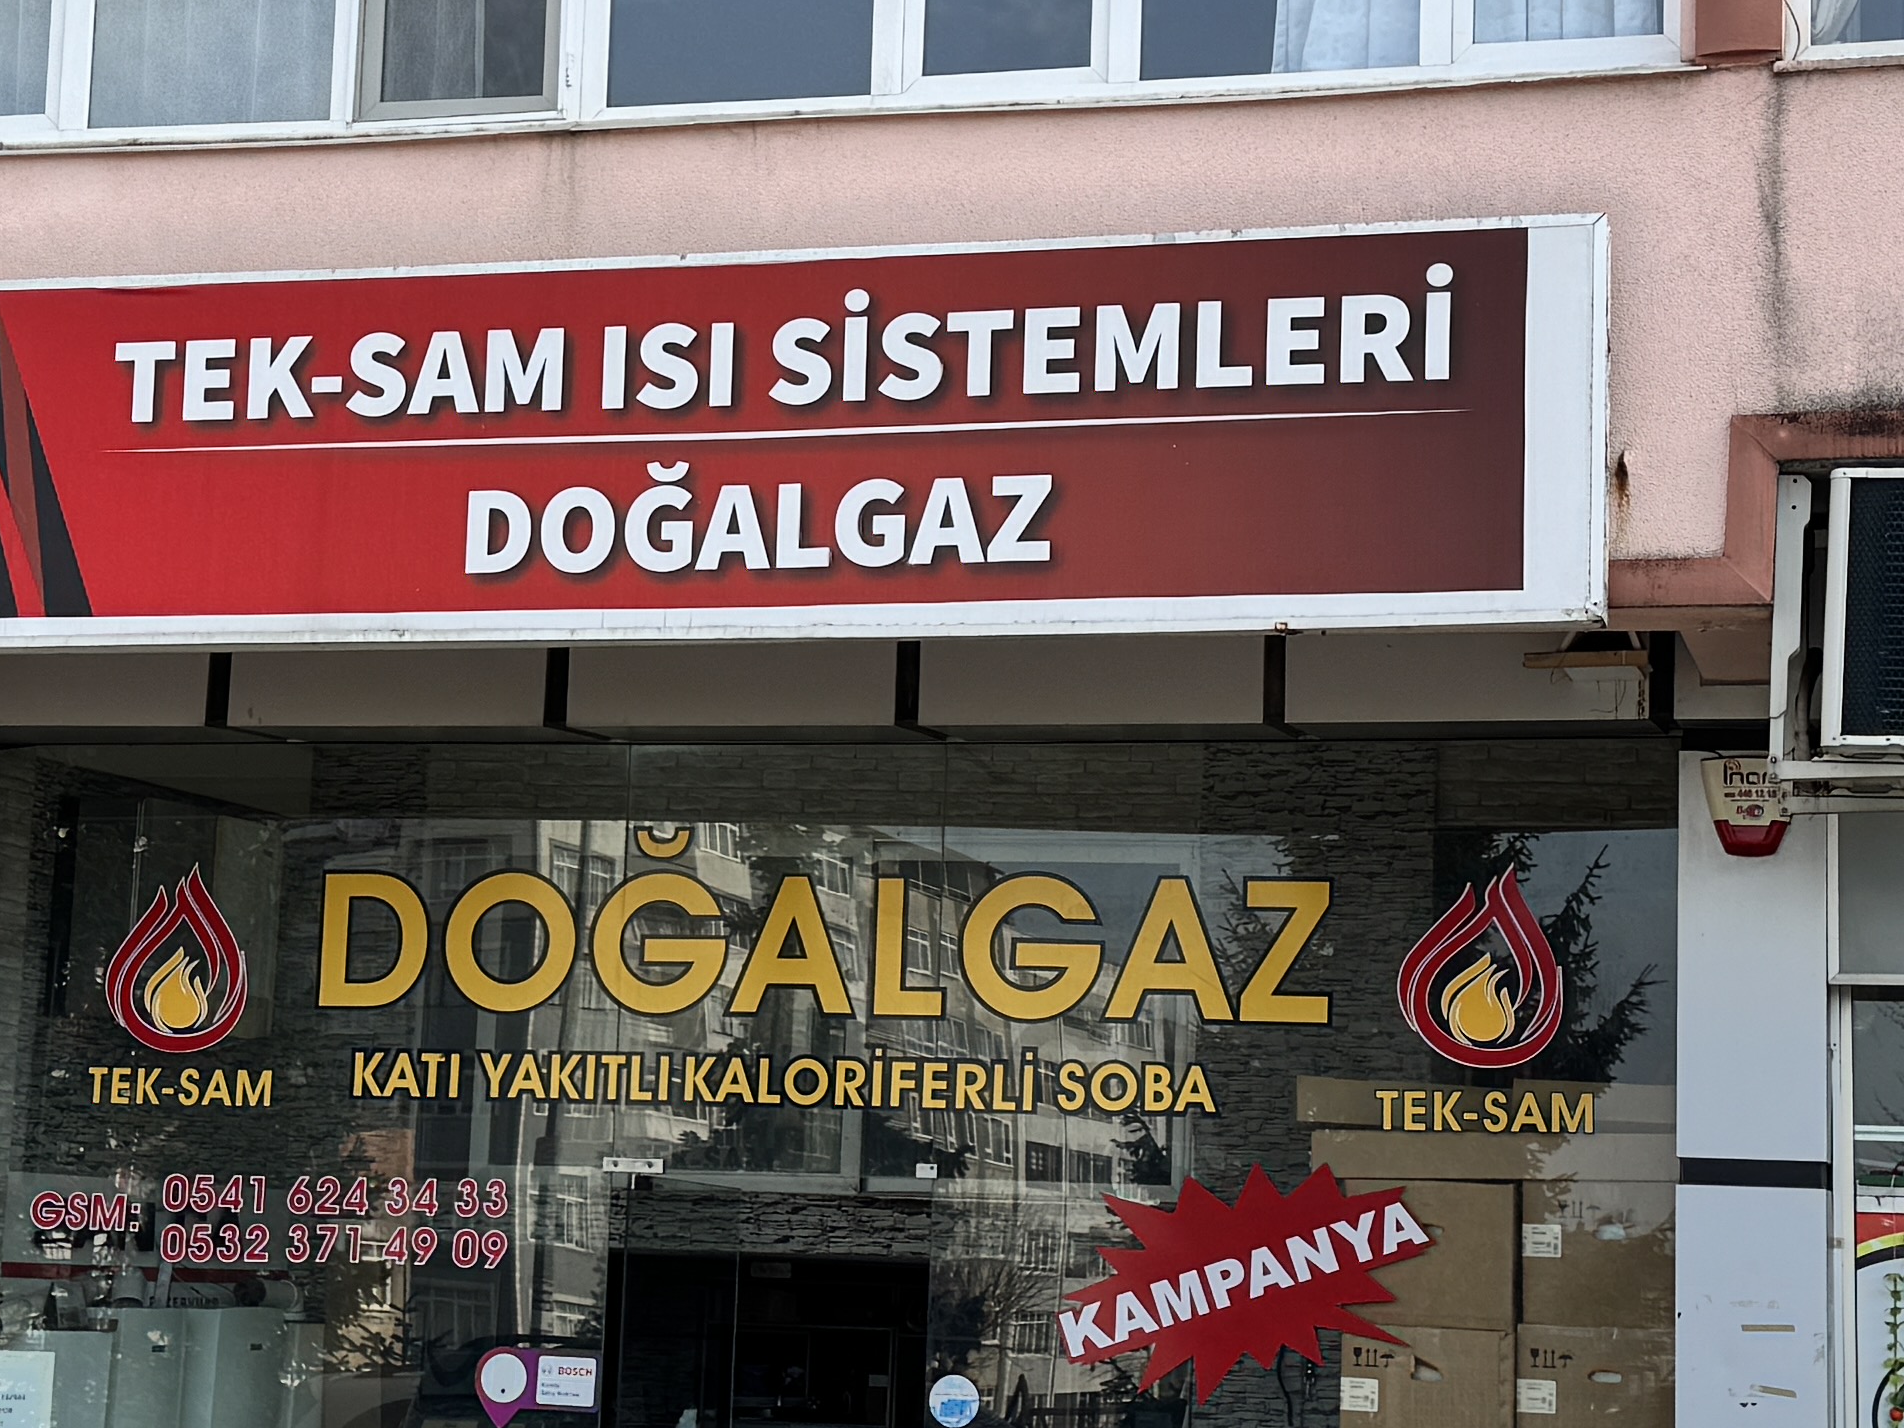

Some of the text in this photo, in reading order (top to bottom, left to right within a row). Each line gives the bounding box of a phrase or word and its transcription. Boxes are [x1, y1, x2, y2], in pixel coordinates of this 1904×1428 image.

[114, 261, 1452, 424] TEK-SAM ISI SİSTEMLERİ
[464, 460, 1053, 576] DOĞALGAZ
[316, 825, 1332, 1025] DOĞALGAZ
[89, 1066, 274, 1107] TEK-SAM
[352, 1047, 1217, 1117] KATI YAKITLI KALORİFERLİ SOBA
[1376, 1089, 1595, 1134] TEK-SAM
[29, 1172, 509, 1233] GSM: 0541 624 34 33
[159, 1222, 509, 1270] 0532 371 49 09
[1057, 1200, 1431, 1362] KAMPANYA
[558, 1366, 592, 1376] BOSCH
